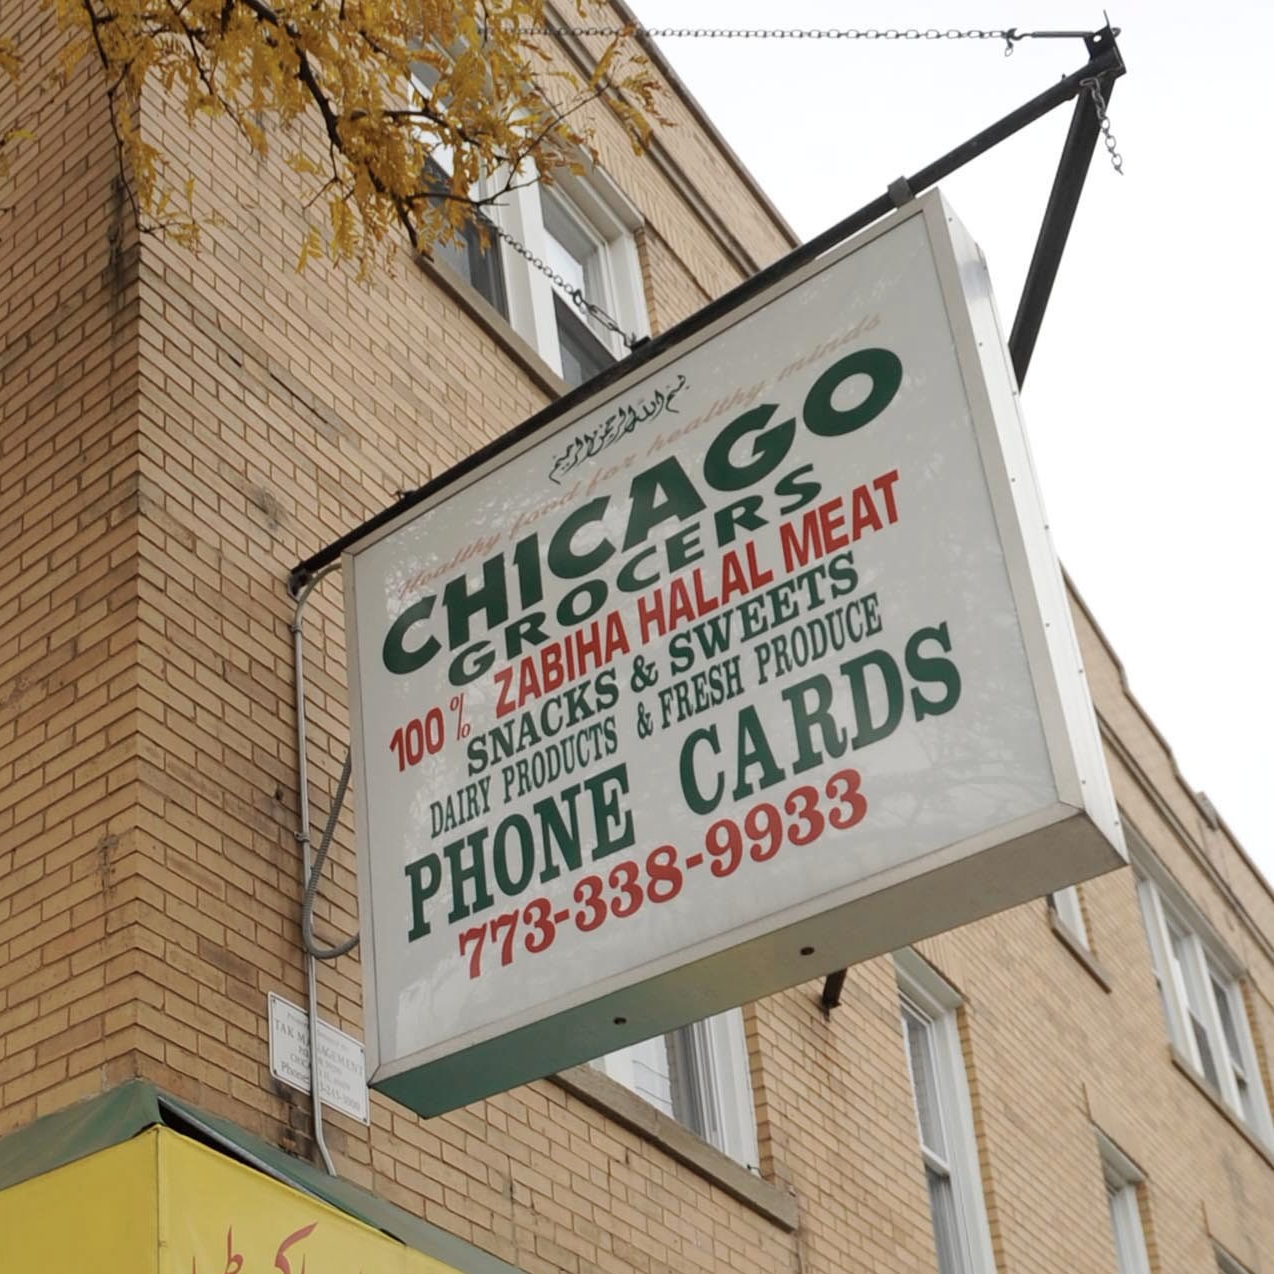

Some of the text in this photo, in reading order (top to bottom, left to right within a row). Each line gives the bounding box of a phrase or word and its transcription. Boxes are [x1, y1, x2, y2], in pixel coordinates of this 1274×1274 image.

[382, 347, 904, 675] CHICAGO
[586, 453, 637, 497] for
[646, 380, 765, 457] healthy
[778, 313, 881, 382] minds
[448, 463, 822, 687] GROCERS
[467, 551, 859, 778] SNACKS & SWEETS
[494, 610, 631, 720] ZABIHA
[637, 541, 774, 646] HALAL
[779, 469, 899, 574] MEAT
[404, 621, 962, 943] PHONE CARDS
[430, 592, 883, 839] DAIRY PRODUCTS & FRESH PRODUCE
[458, 768, 868, 980] 773-338-9933
